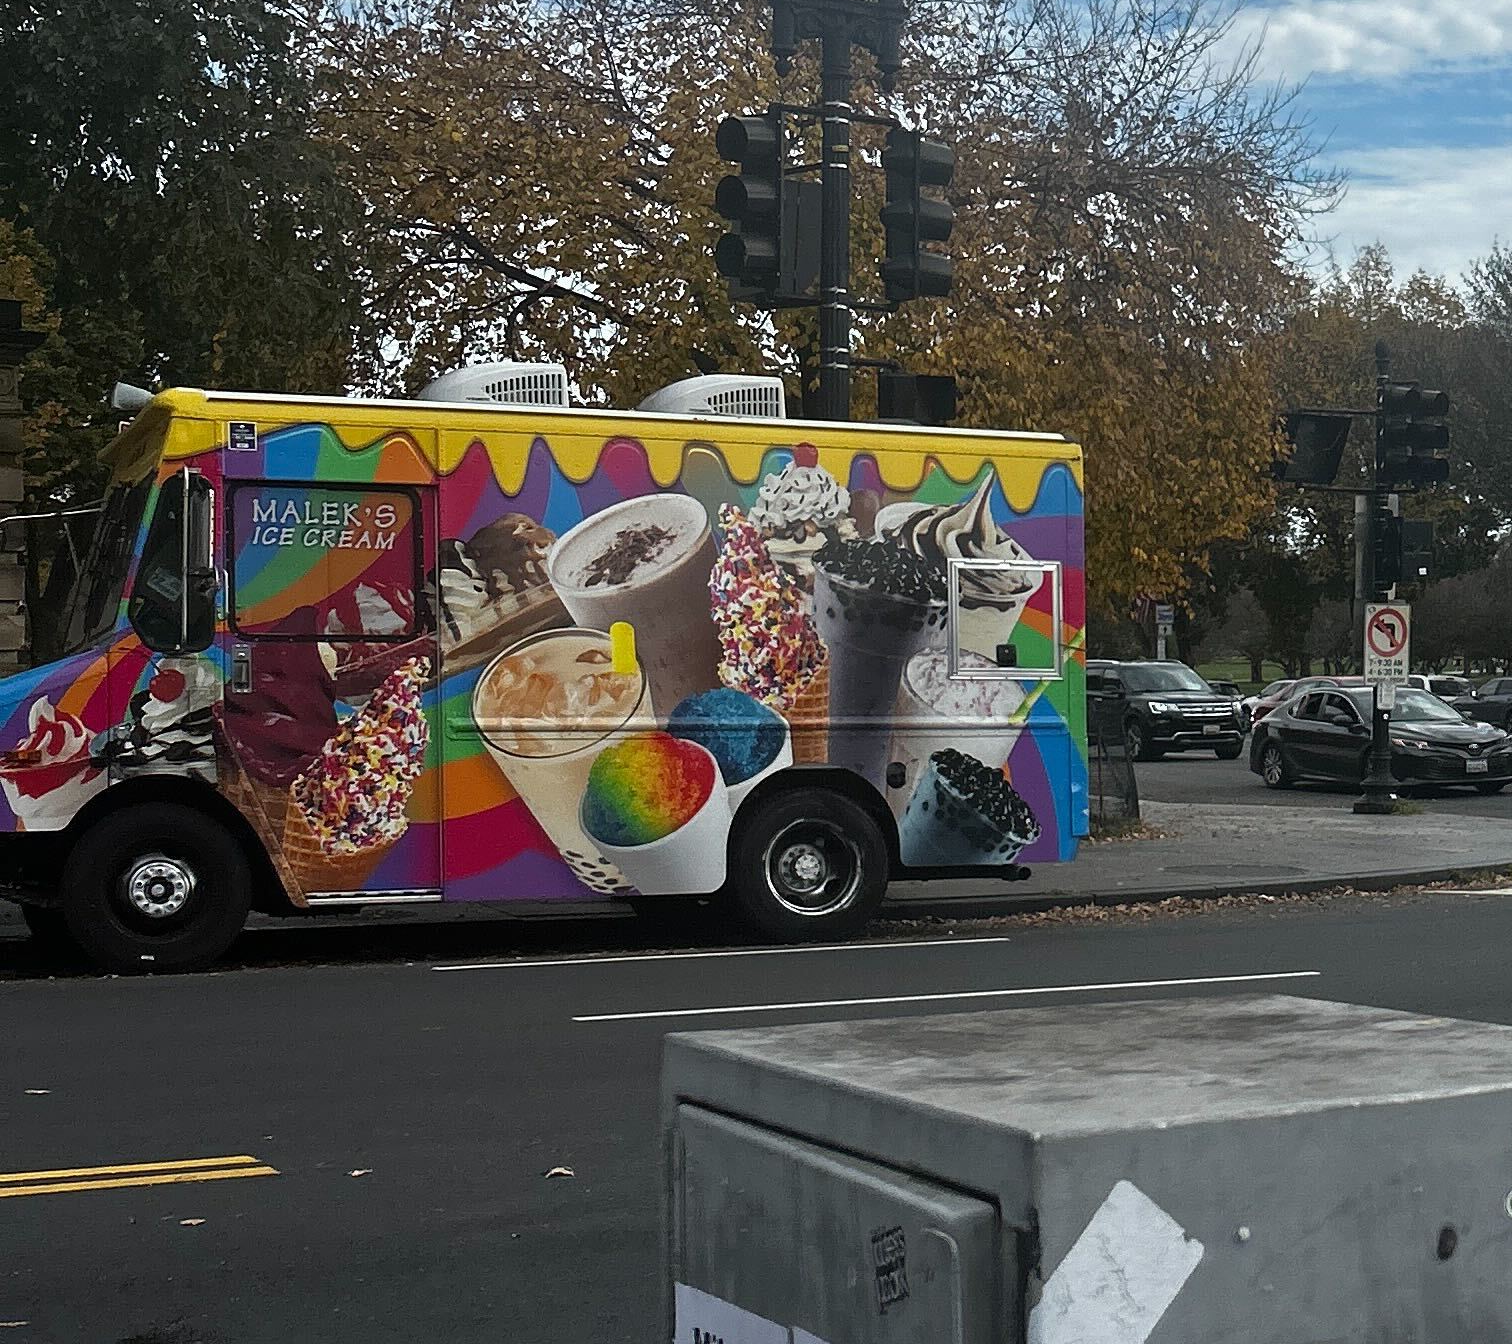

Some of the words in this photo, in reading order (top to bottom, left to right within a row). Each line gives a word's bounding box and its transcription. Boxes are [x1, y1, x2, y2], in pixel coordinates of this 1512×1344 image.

[253, 498, 397, 528] MALEK'S
[252, 526, 296, 545] ICE
[303, 528, 397, 550] CREAM
